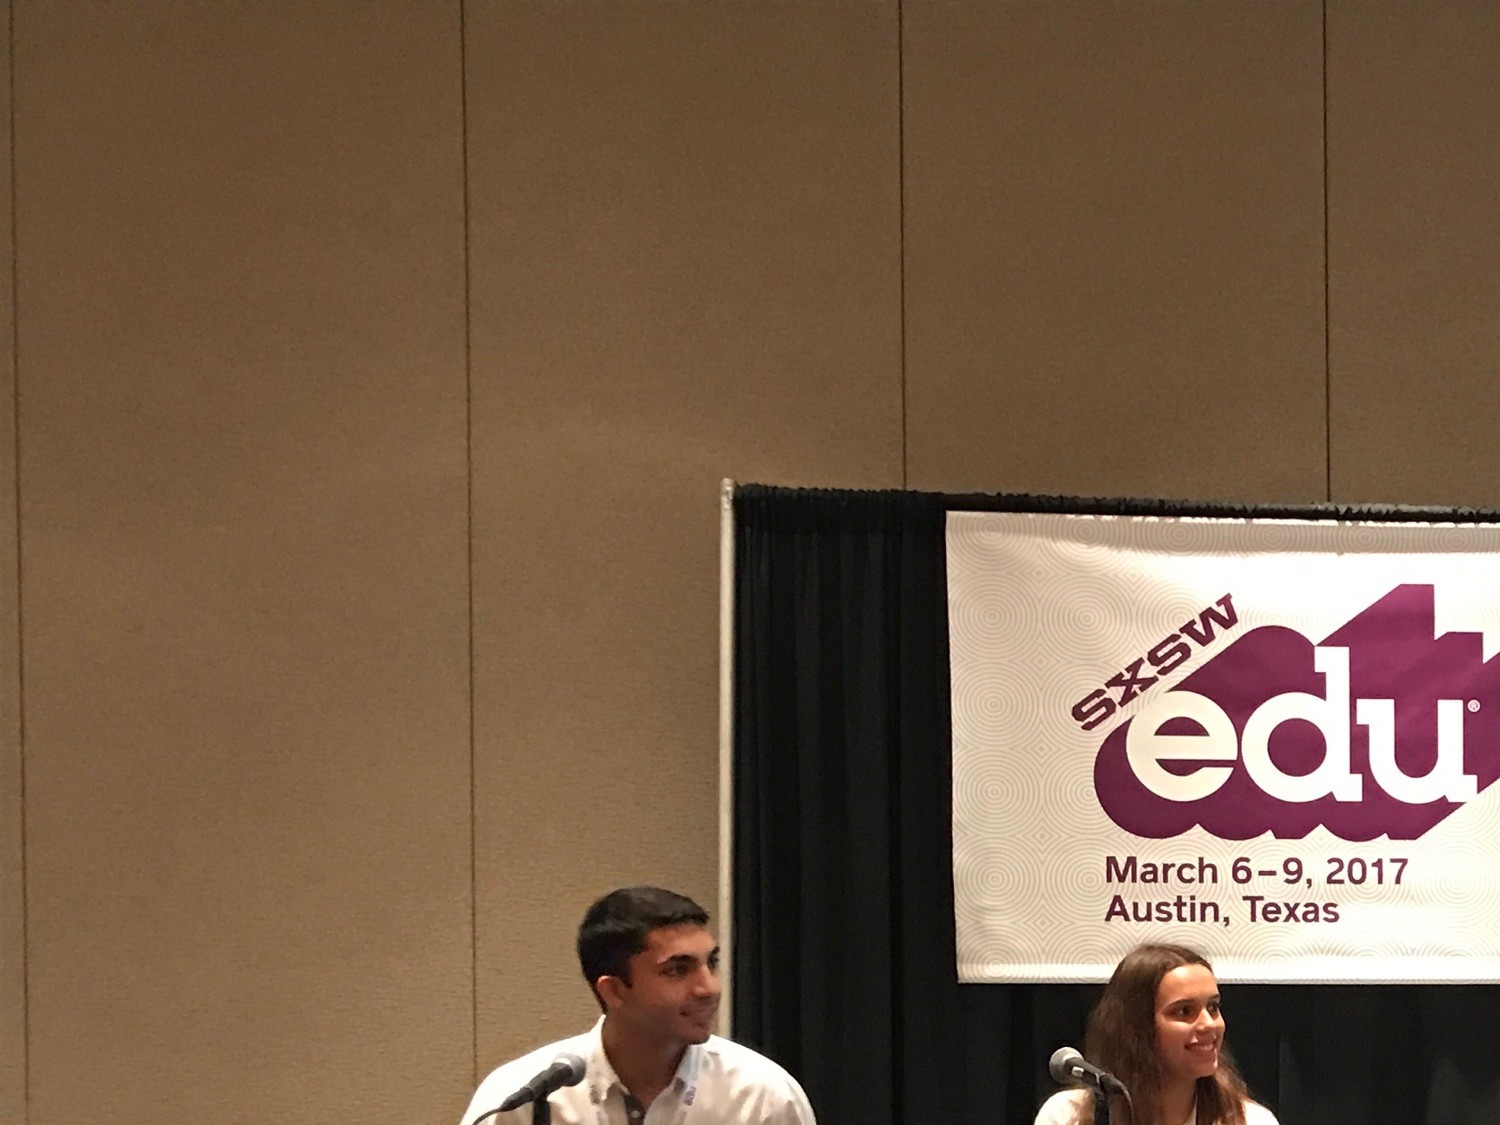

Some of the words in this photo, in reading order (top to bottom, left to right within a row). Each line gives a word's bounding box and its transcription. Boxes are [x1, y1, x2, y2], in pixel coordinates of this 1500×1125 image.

[1071, 592, 1239, 732] SXSW
[1105, 856, 1218, 884] March
[1326, 857, 1409, 885] 2017
[1104, 894, 1231, 927] Austin,
[1242, 895, 1340, 923] Texas
